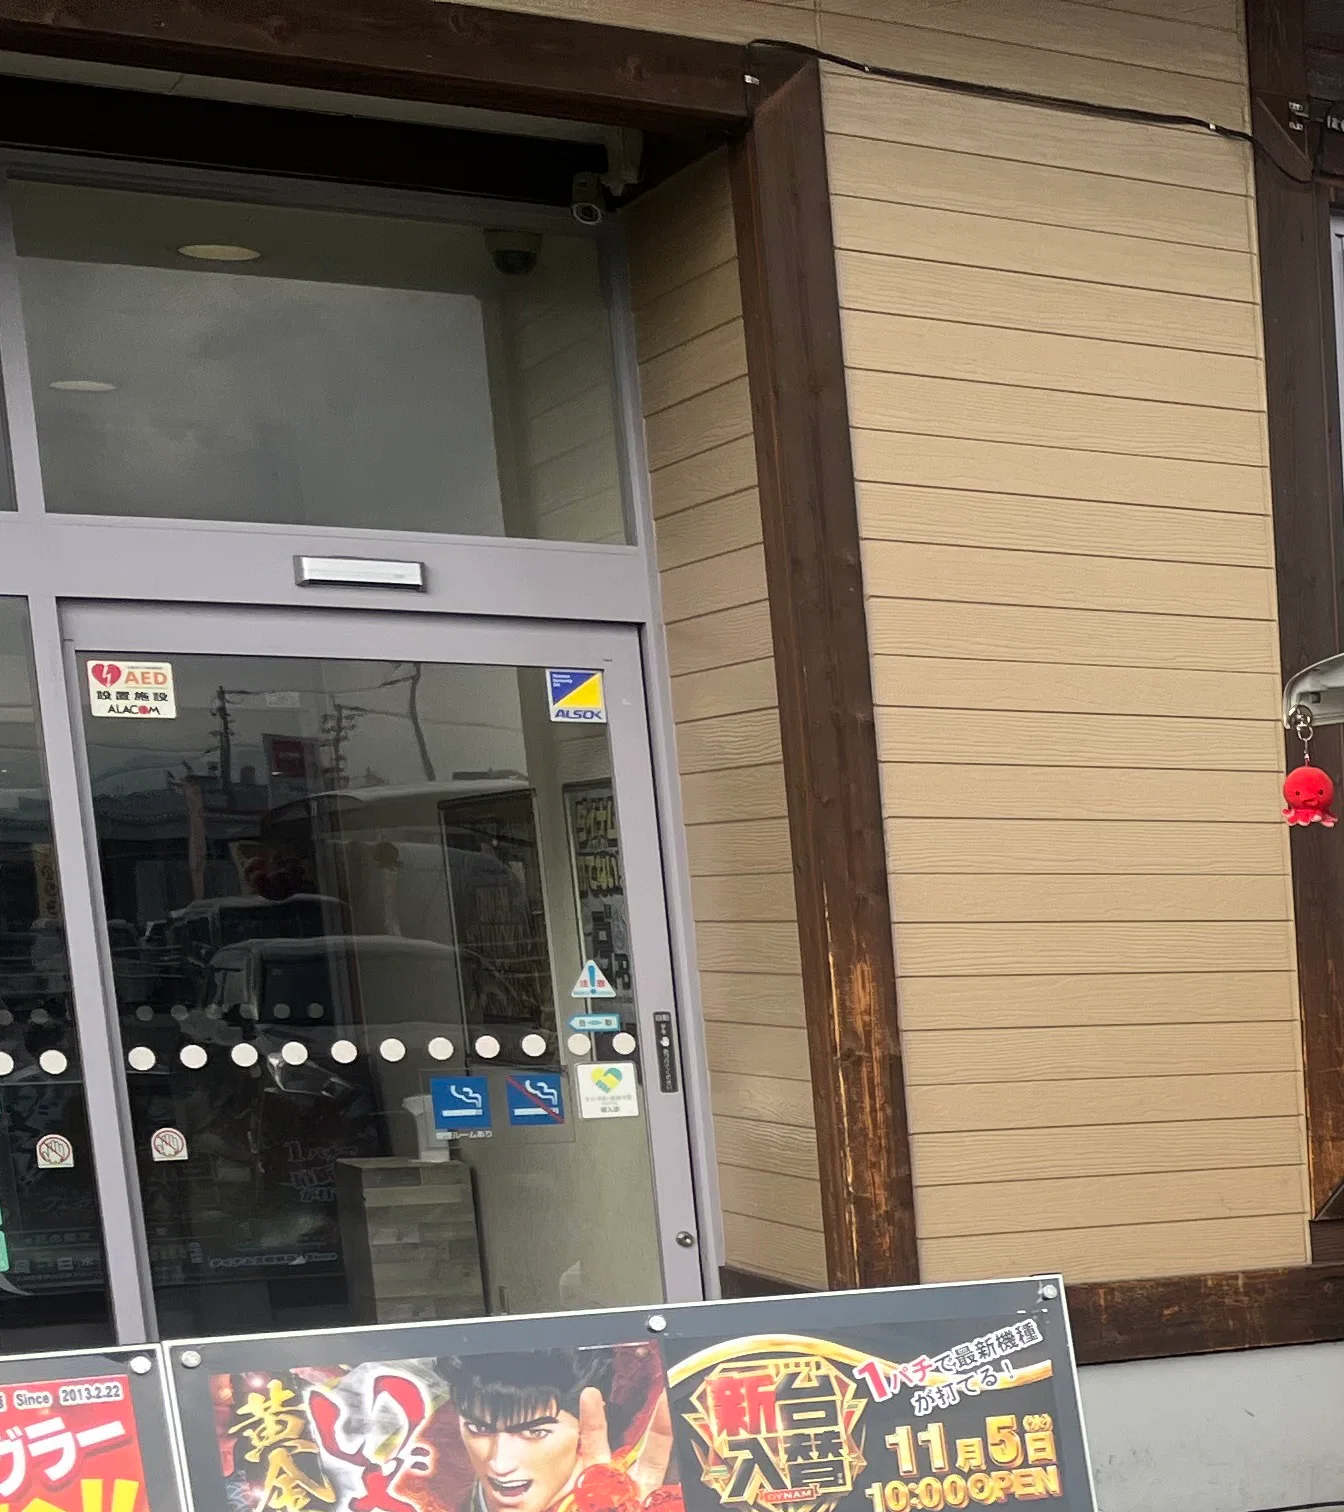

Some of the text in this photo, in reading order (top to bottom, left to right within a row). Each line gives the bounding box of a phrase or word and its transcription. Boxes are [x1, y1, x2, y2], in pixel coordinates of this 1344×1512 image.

[125, 670, 168, 686] AED
[555, 709, 604, 720] ALSOK
[15, 1390, 50, 1407] Since
[61, 1385, 121, 1402] 2013.2.22
[766, 1488, 814, 1501] DYNAM
